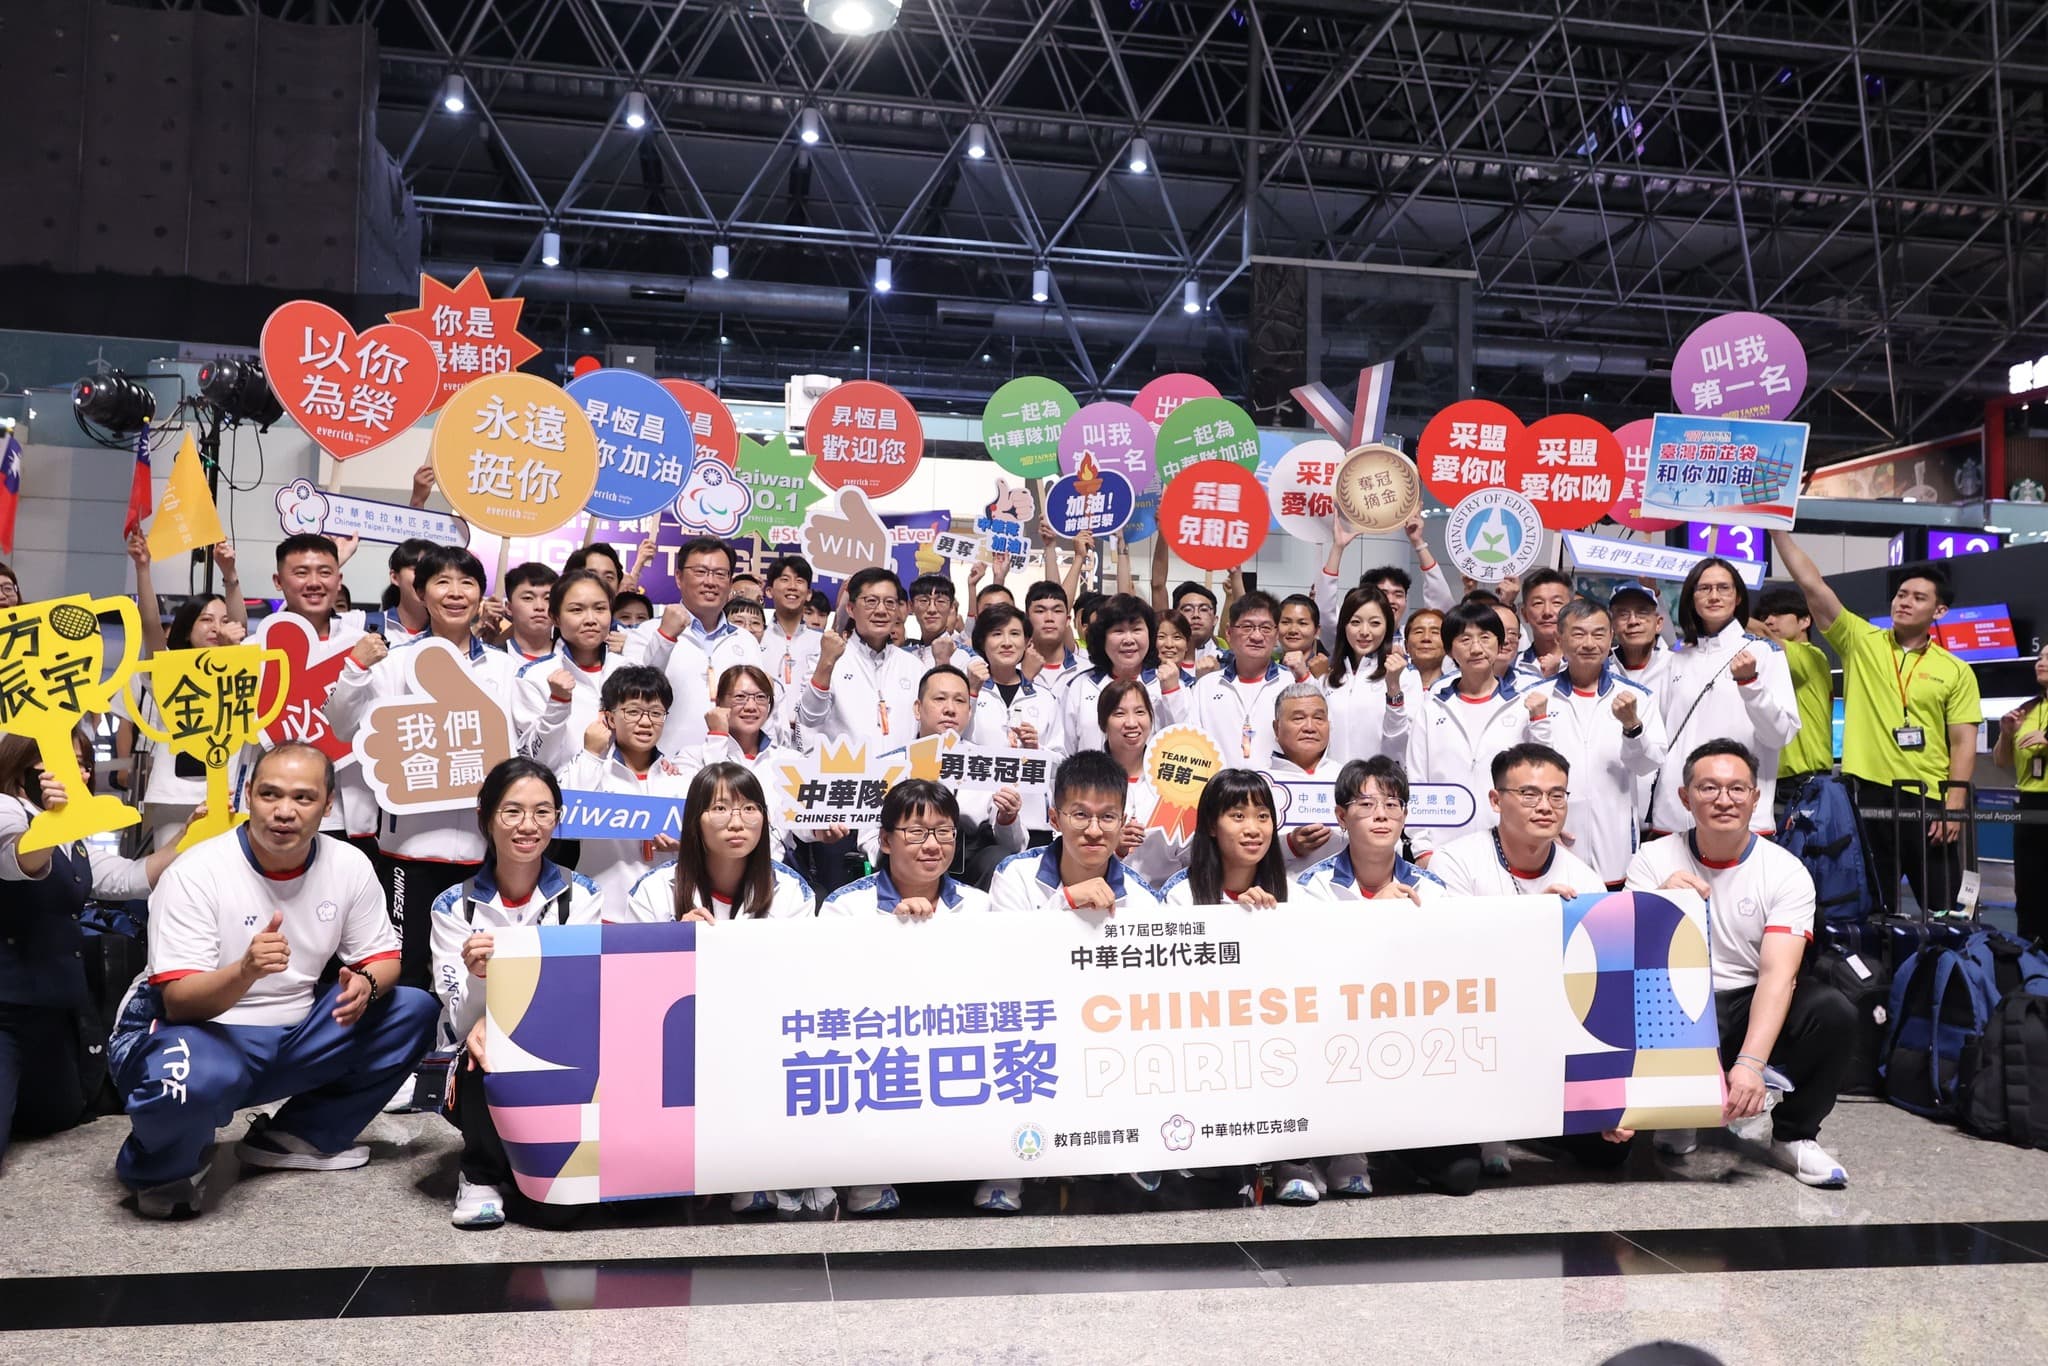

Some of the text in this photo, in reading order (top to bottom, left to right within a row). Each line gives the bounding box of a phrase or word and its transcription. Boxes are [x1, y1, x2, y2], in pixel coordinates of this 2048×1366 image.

[431, 304, 495, 339] 你是
[299, 326, 409, 385] 以你
[1701, 334, 1768, 373] 叫我
[1691, 364, 1791, 411] 第一名
[301, 375, 398, 432] 為榮
[1002, 400, 1060, 422] 一起為
[473, 394, 567, 452] 永遠
[584, 399, 664, 444] 昇恆昌
[831, 406, 898, 431] 昇恆昌
[317, 426, 353, 442] everrich
[988, 422, 1066, 451] 中華隊加
[1083, 422, 1132, 447] 叫我
[1174, 420, 1235, 447] 一起為
[1449, 422, 1507, 452] 采盟
[822, 433, 907, 466] 歡迎您
[1537, 439, 1598, 467] 采盟
[467, 449, 562, 505] 挺你
[1359, 470, 1393, 491] 奪冠
[1521, 473, 1612, 503] 愛你呦
[1657, 464, 1754, 486] 和你加油
[594, 490, 617, 502] errich
[752, 488, 798, 513] O.1
[1065, 492, 1114, 517] 加油!
[1364, 489, 1397, 510] 摘金
[335, 518, 361, 528] Chinese
[364, 521, 385, 533] Taipei
[1065, 514, 1114, 532] 前進巴黎
[1452, 494, 1537, 564] MINISTRY OF EDUCATION
[819, 533, 875, 562] WIN
[1462, 557, 1517, 578] 教育部
[163, 668, 258, 740] 金牌
[398, 710, 482, 752] 我們
[402, 748, 485, 792] 會贏
[940, 752, 1047, 785] 勇奪冠軍
[1162, 751, 1212, 768] TEAM WIN!
[797, 779, 888, 809] 中華隊
[794, 813, 882, 823] CHINESE TAIPE
[1298, 806, 1457, 815] Chinese Committee
[1994, 811, 2022, 822] Airport
[393, 867, 406, 921] CHINESE
[1104, 921, 1206, 939] 第17屆巴黎帕運
[1070, 941, 1241, 971] 中華台北代表團
[1081, 977, 1497, 1033] CHINESE TAIPEI
[781, 999, 1057, 1043] 中華台北帕運選手
[162, 1037, 187, 1106] TPE
[1083, 1026, 1497, 1098] PARIS 2024
[782, 1039, 1059, 1117] 前進巴黎
[1054, 1127, 1140, 1149] 教育部體育署
[1201, 1117, 1310, 1140] 中華帕林匹克總會
